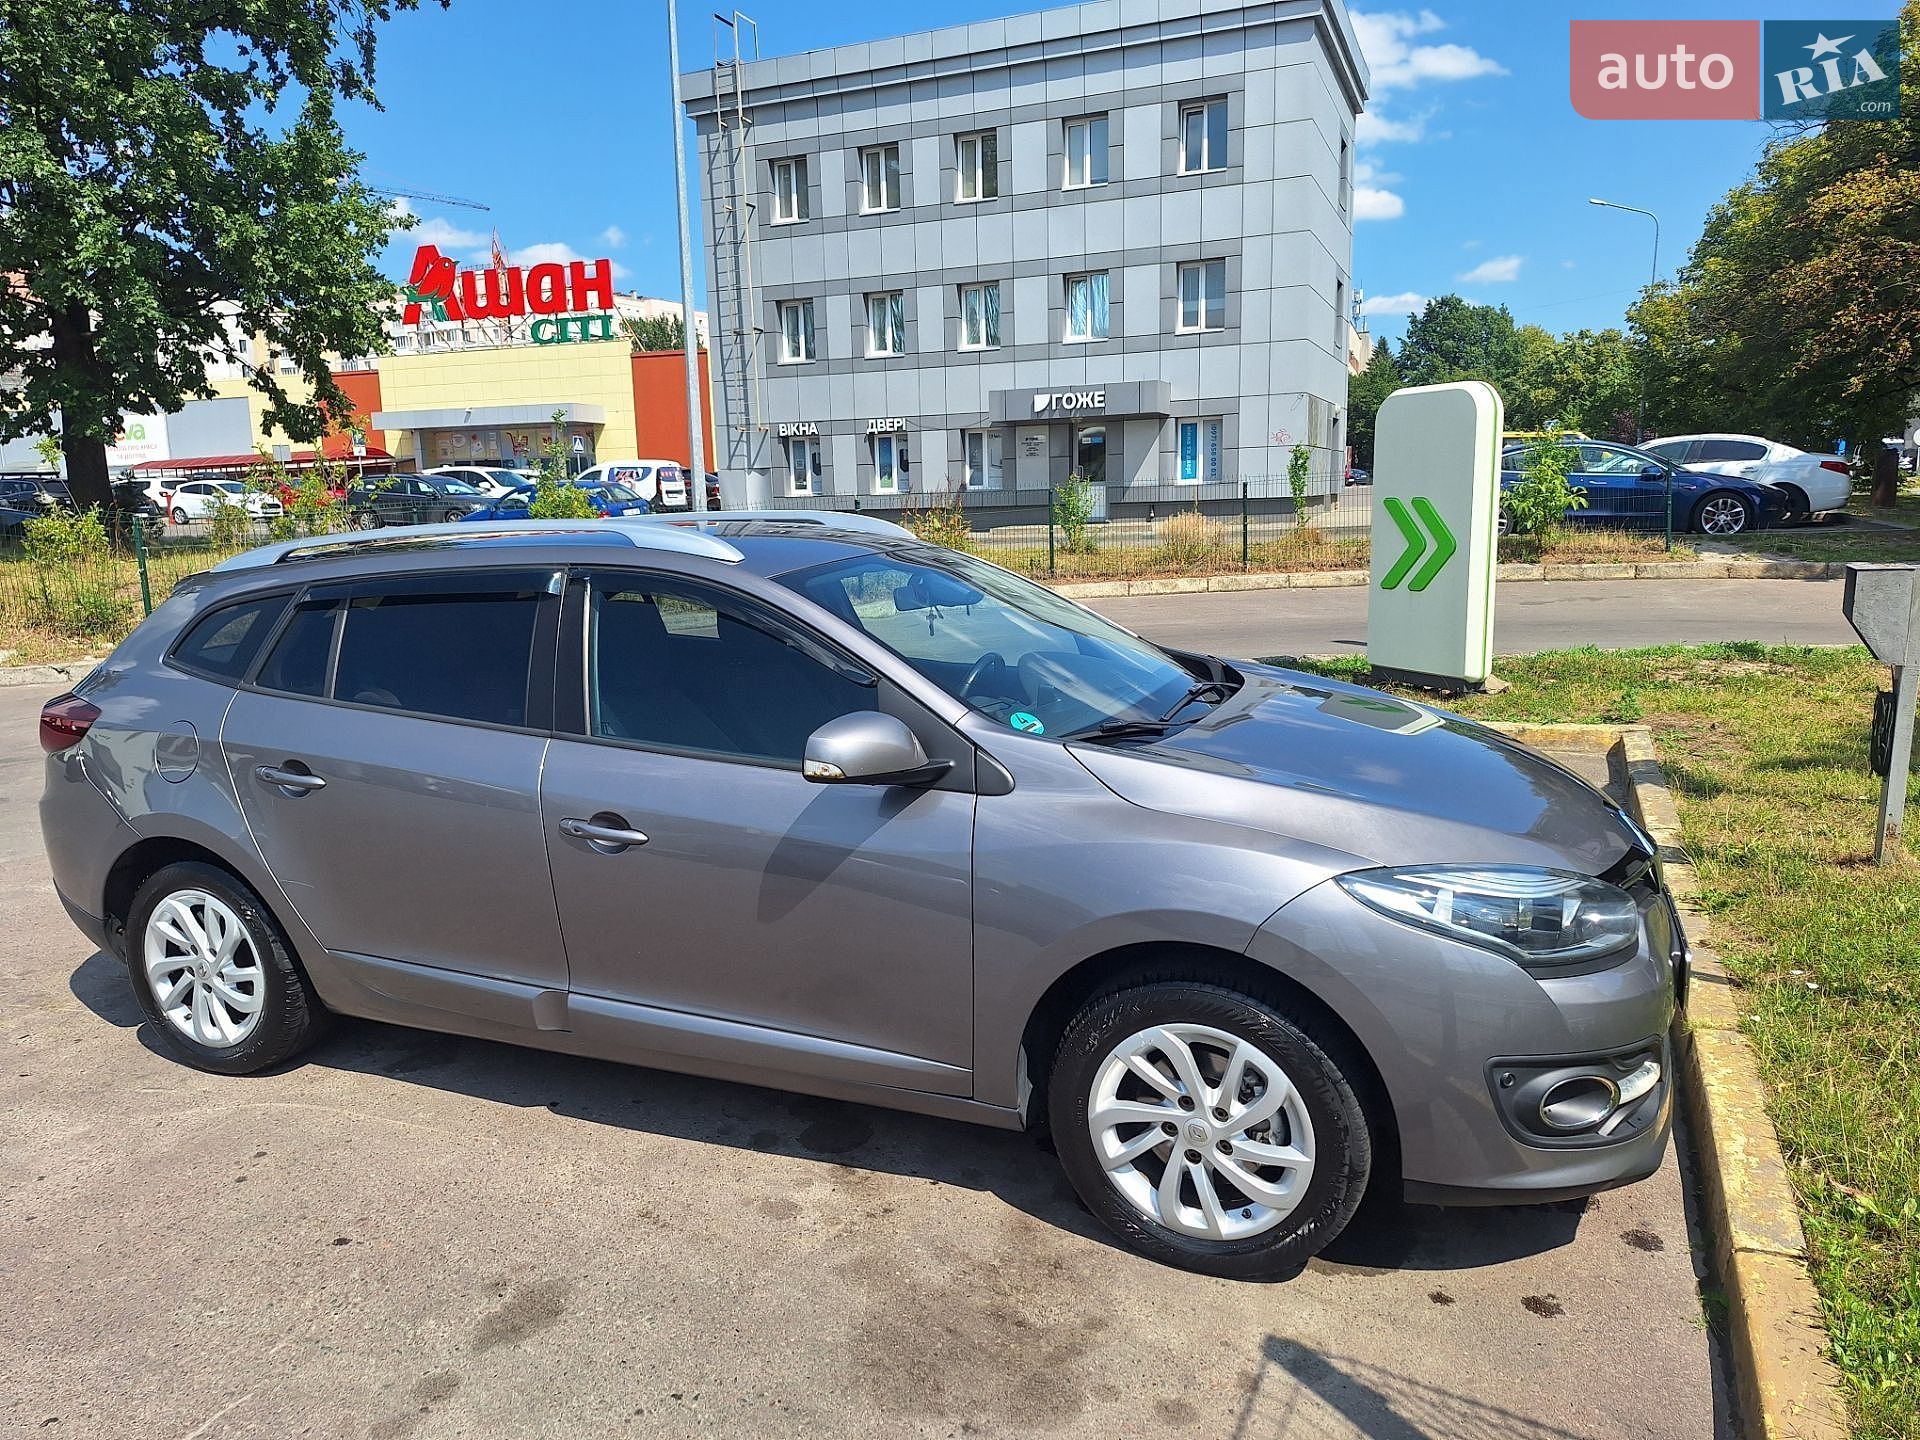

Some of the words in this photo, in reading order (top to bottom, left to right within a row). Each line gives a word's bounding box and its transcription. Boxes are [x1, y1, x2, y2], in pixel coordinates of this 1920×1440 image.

[1051, 390, 1106, 411] ГОЖЕ
[778, 421, 819, 438] ВІКНА
[866, 417, 907, 435] ДВЕРІ
